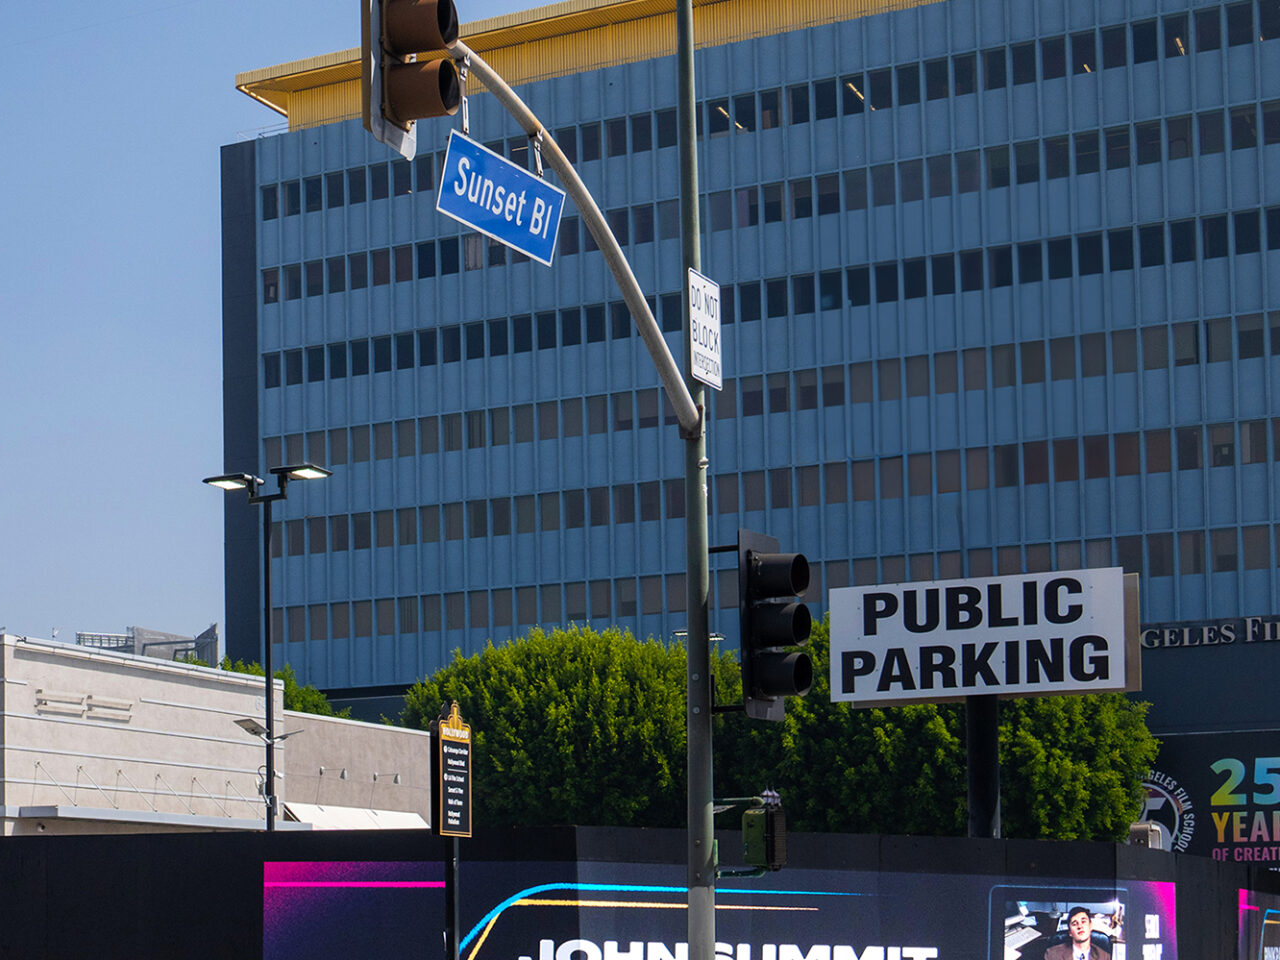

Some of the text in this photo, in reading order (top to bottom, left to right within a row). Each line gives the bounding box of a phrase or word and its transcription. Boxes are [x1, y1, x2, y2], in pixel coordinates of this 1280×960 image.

[454, 157, 554, 240] Sunset Bl
[691, 284, 718, 320] DO NOT
[692, 319, 720, 355] BLOCK
[862, 577, 1084, 637] PUBLIC
[1140, 623, 1236, 648] GELES
[840, 634, 1110, 695] PARKING
[1173, 786, 1193, 812] FILM
[1209, 756, 1280, 807] 25
[1174, 812, 1195, 853] SCHOOL
[1212, 848, 1229, 861] OF
